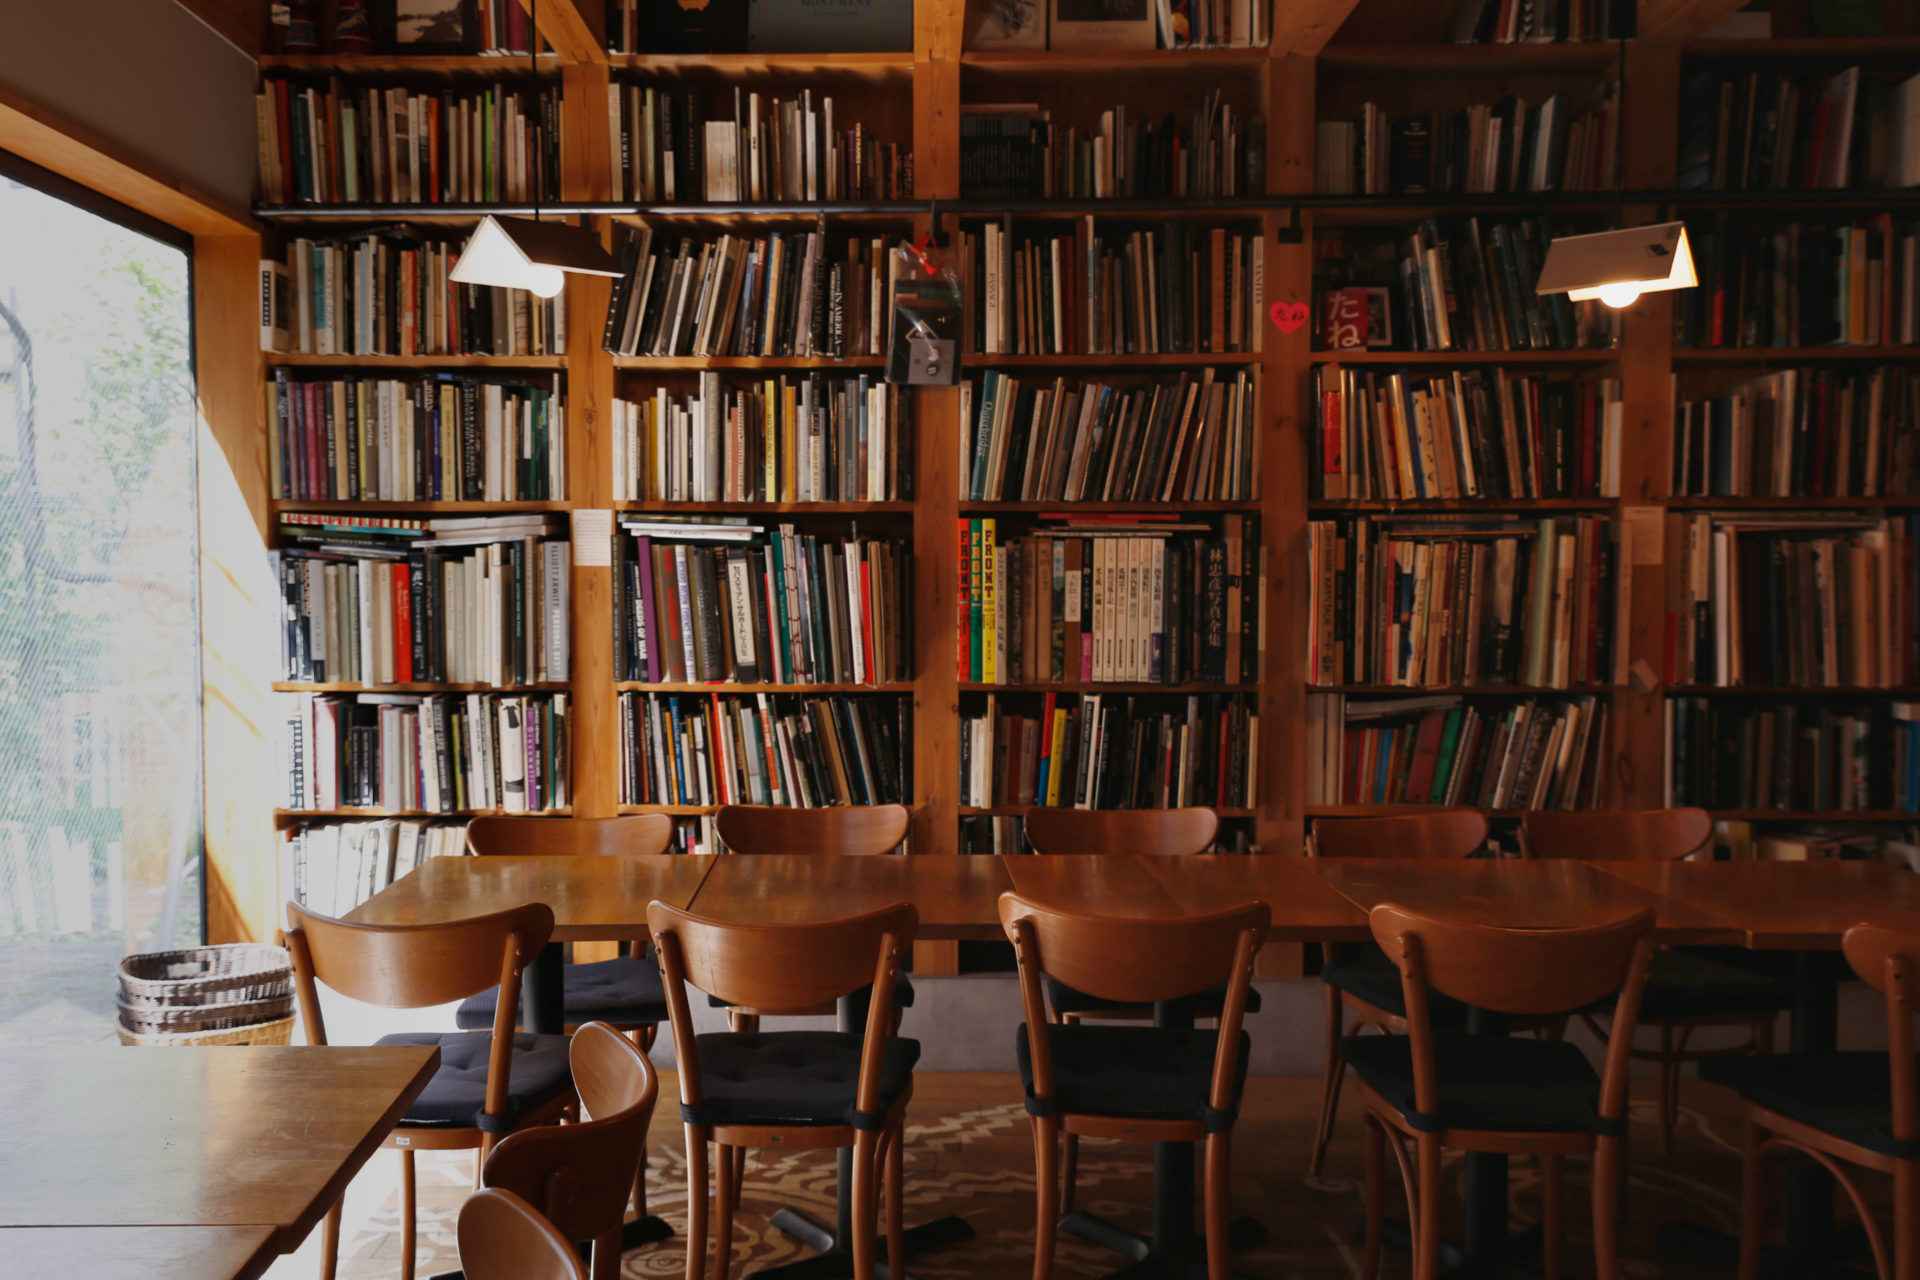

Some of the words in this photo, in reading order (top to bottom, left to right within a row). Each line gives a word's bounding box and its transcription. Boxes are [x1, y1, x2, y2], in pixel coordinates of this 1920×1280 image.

[834, 292, 843, 303] IN
[989, 273, 997, 309] PASSAGE
[834, 304, 843, 345] AMERICA
[1328, 291, 1361, 349] たね
[978, 400, 993, 458] Outerbridge
[551, 545, 559, 575] ELLIOTT
[960, 529, 970, 594] FRONT
[971, 531, 982, 602] FRONT
[984, 529, 994, 593] FRONT
[552, 578, 560, 607] ERWITT
[1208, 546, 1223, 648] 林忠彦写真全集
[552, 609, 561, 648] PERSONAL
[635, 599, 644, 626] DEEDS
[637, 628, 646, 639] OF
[639, 640, 647, 660] WAR
[553, 651, 561, 671] BEST
